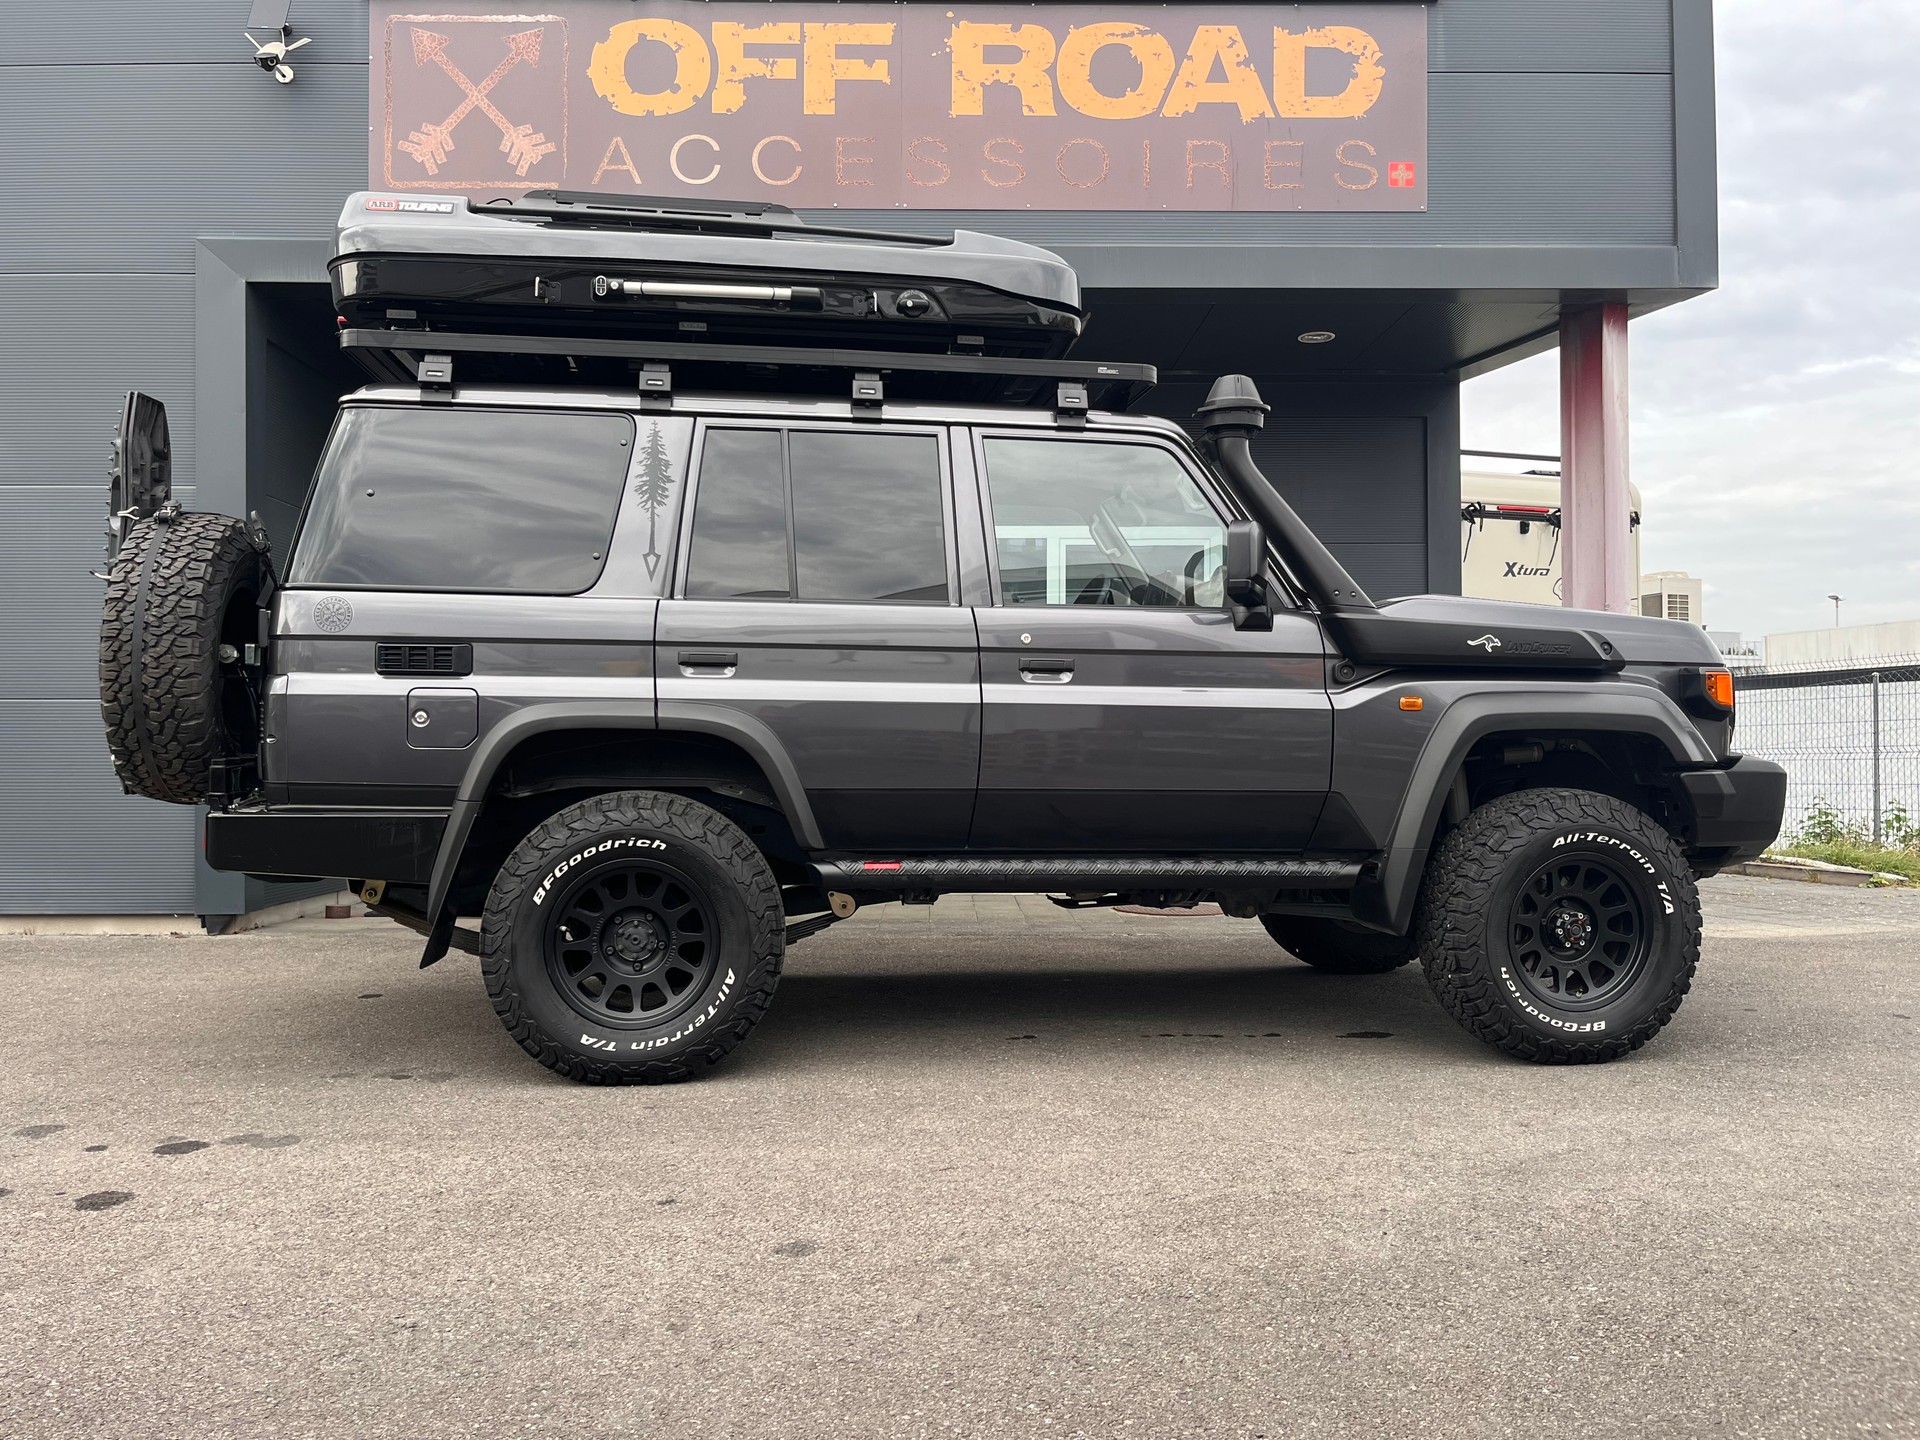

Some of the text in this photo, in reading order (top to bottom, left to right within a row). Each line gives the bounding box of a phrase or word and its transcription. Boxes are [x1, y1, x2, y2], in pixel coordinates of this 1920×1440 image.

[588, 19, 1384, 121] OFF ROAD
[591, 133, 1379, 192] ACCESSOIRES
[398, 201, 453, 212] TOURING
[1503, 561, 1550, 577] Xtura
[532, 837, 667, 905] BFGoodrich
[1552, 832, 1674, 915] All-Terrain T/A
[579, 968, 736, 1052] All-Terrain T/A
[1500, 967, 1606, 1033] BFGoodrich
